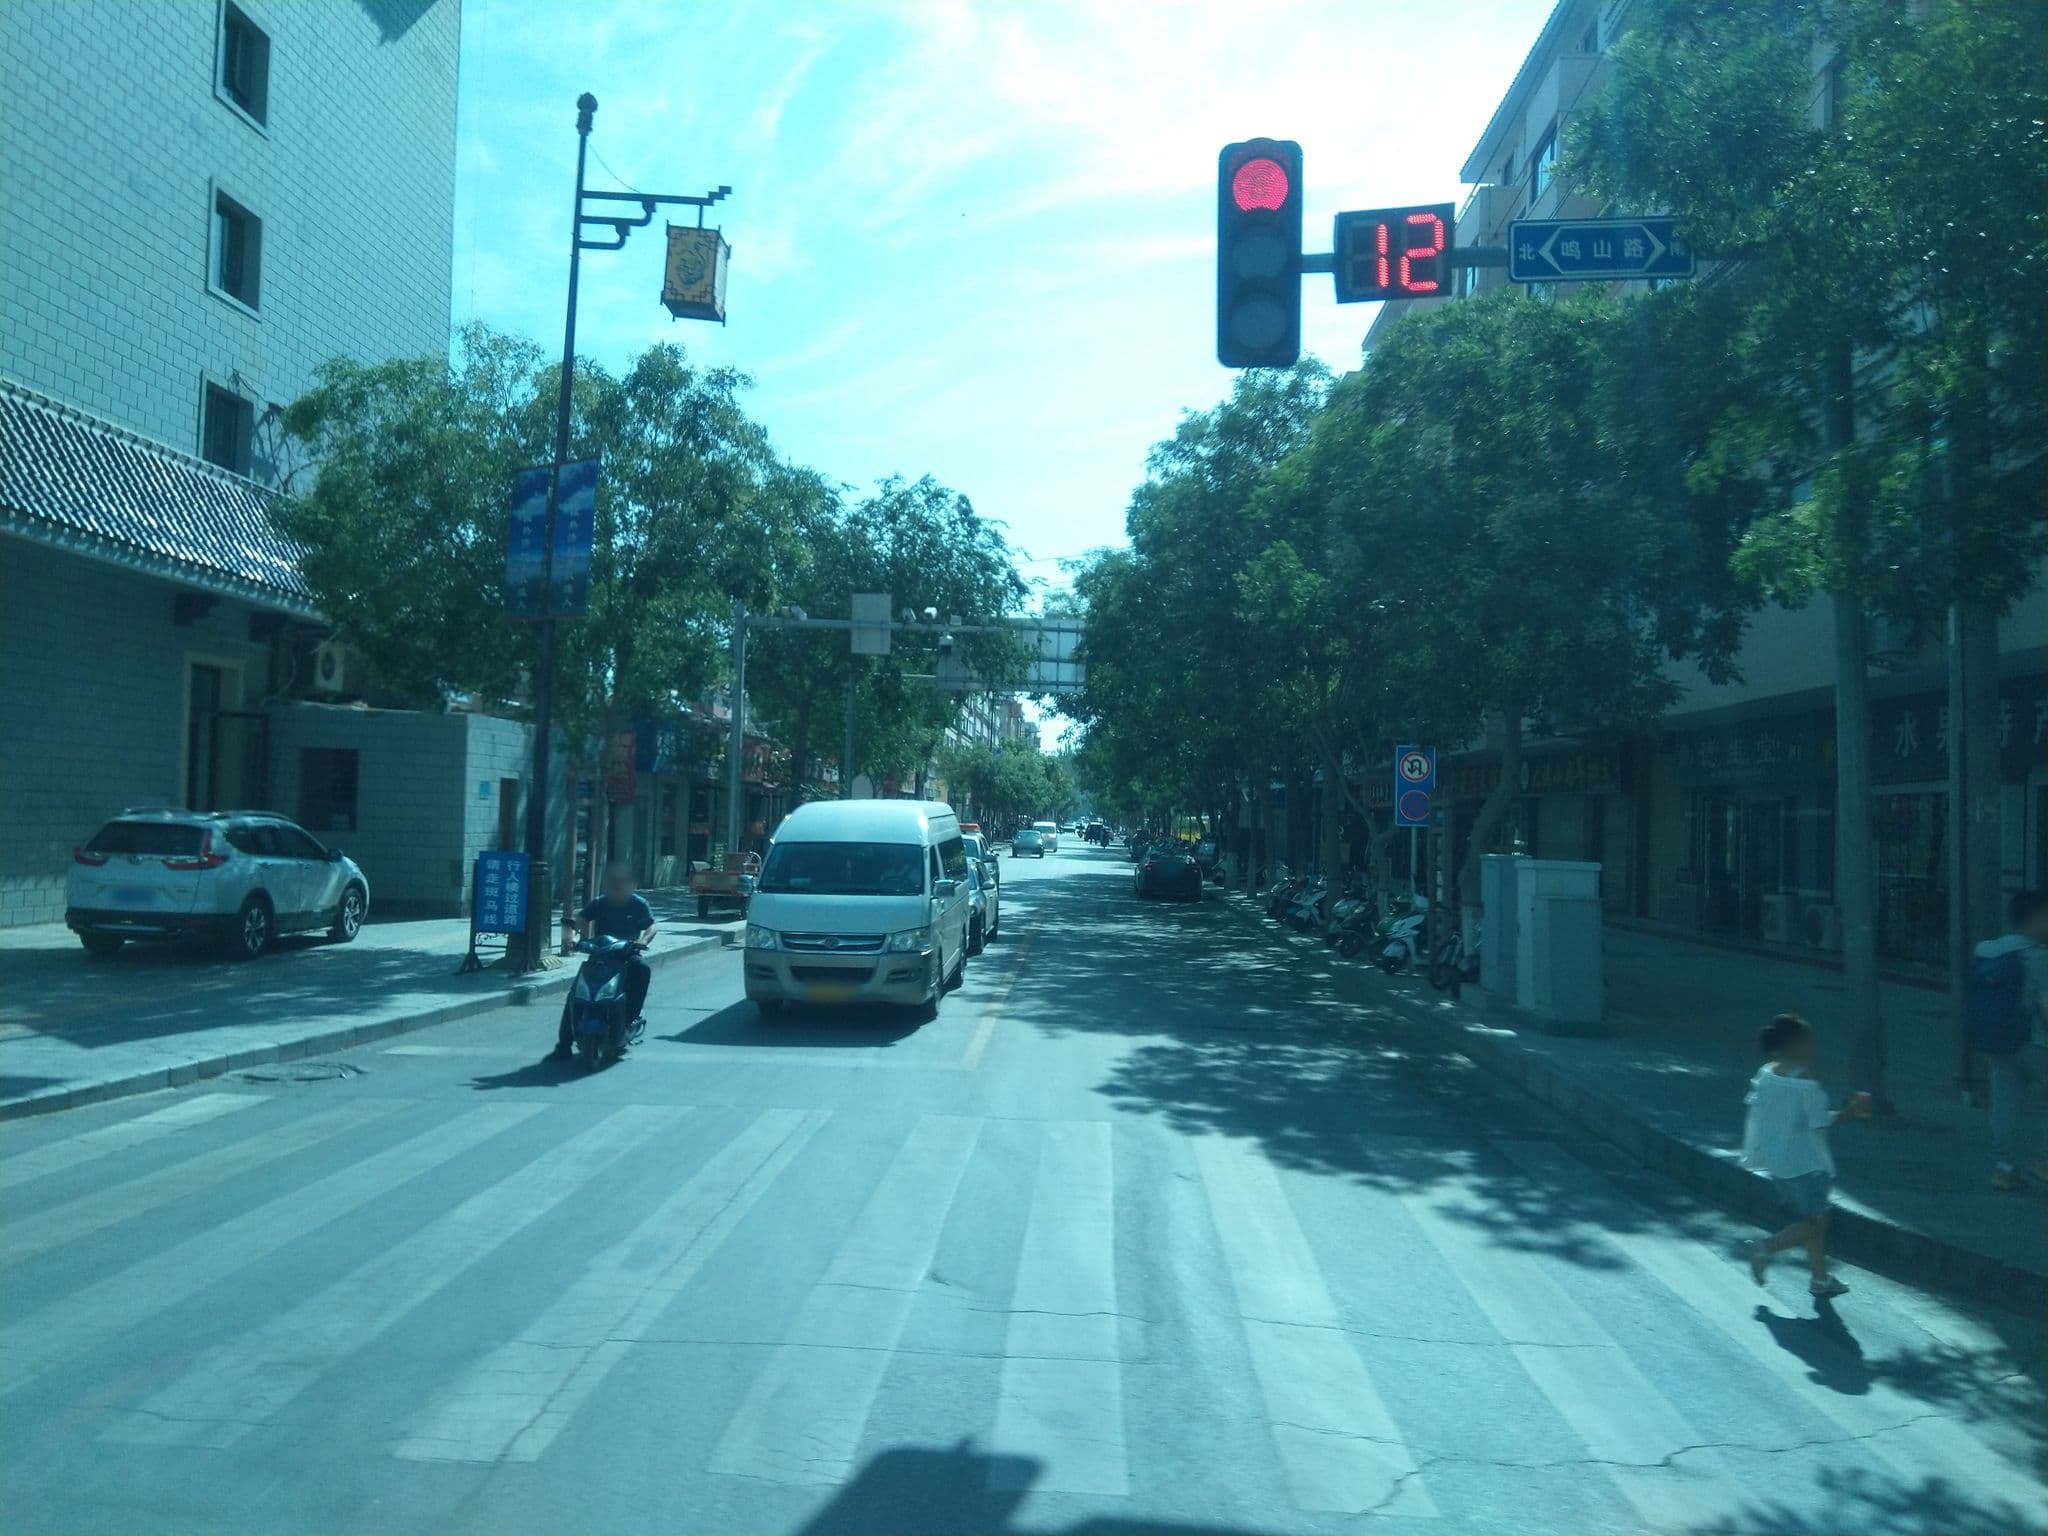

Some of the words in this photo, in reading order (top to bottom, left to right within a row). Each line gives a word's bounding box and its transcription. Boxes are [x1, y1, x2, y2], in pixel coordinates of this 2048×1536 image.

[1376, 212, 1445, 293] 12
[1518, 243, 1536, 261] 北
[1561, 239, 1644, 260] 鸣山路
[484, 859, 500, 925] 请走斑马线
[504, 860, 520, 925] 行人横过道路
